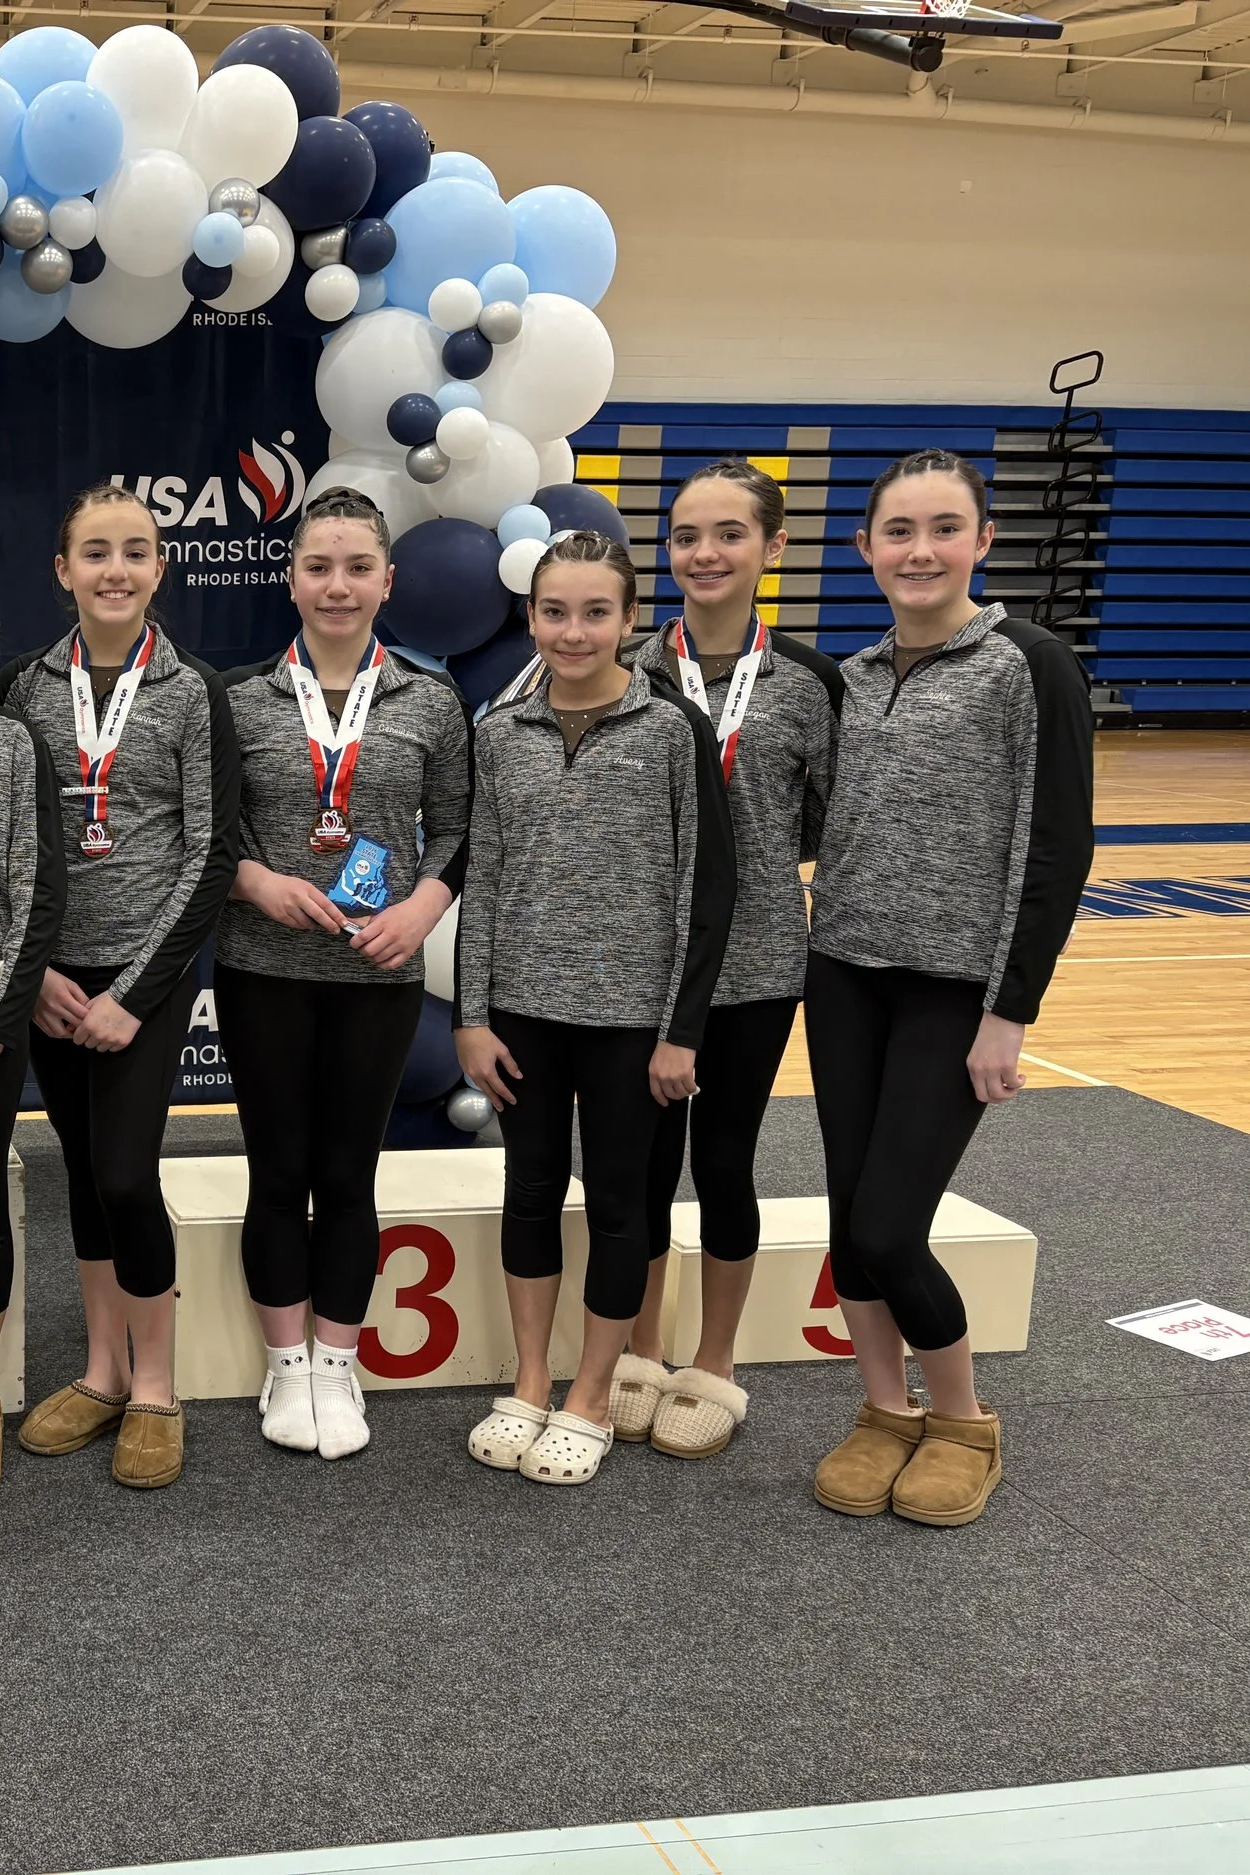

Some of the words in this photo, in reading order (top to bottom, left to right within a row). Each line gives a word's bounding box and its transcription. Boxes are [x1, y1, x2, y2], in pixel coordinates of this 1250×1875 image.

[193, 312, 248, 326] RHODE
[160, 533, 291, 563] mnastic
[186, 571, 240, 587] RHODE
[244, 571, 290, 585] ISLAN
[76, 686, 84, 701] USA
[349, 685, 366, 728] STATE
[730, 672, 748, 717] STATE
[108, 688, 128, 736] STATE
[356, 1223, 460, 1379] 3
